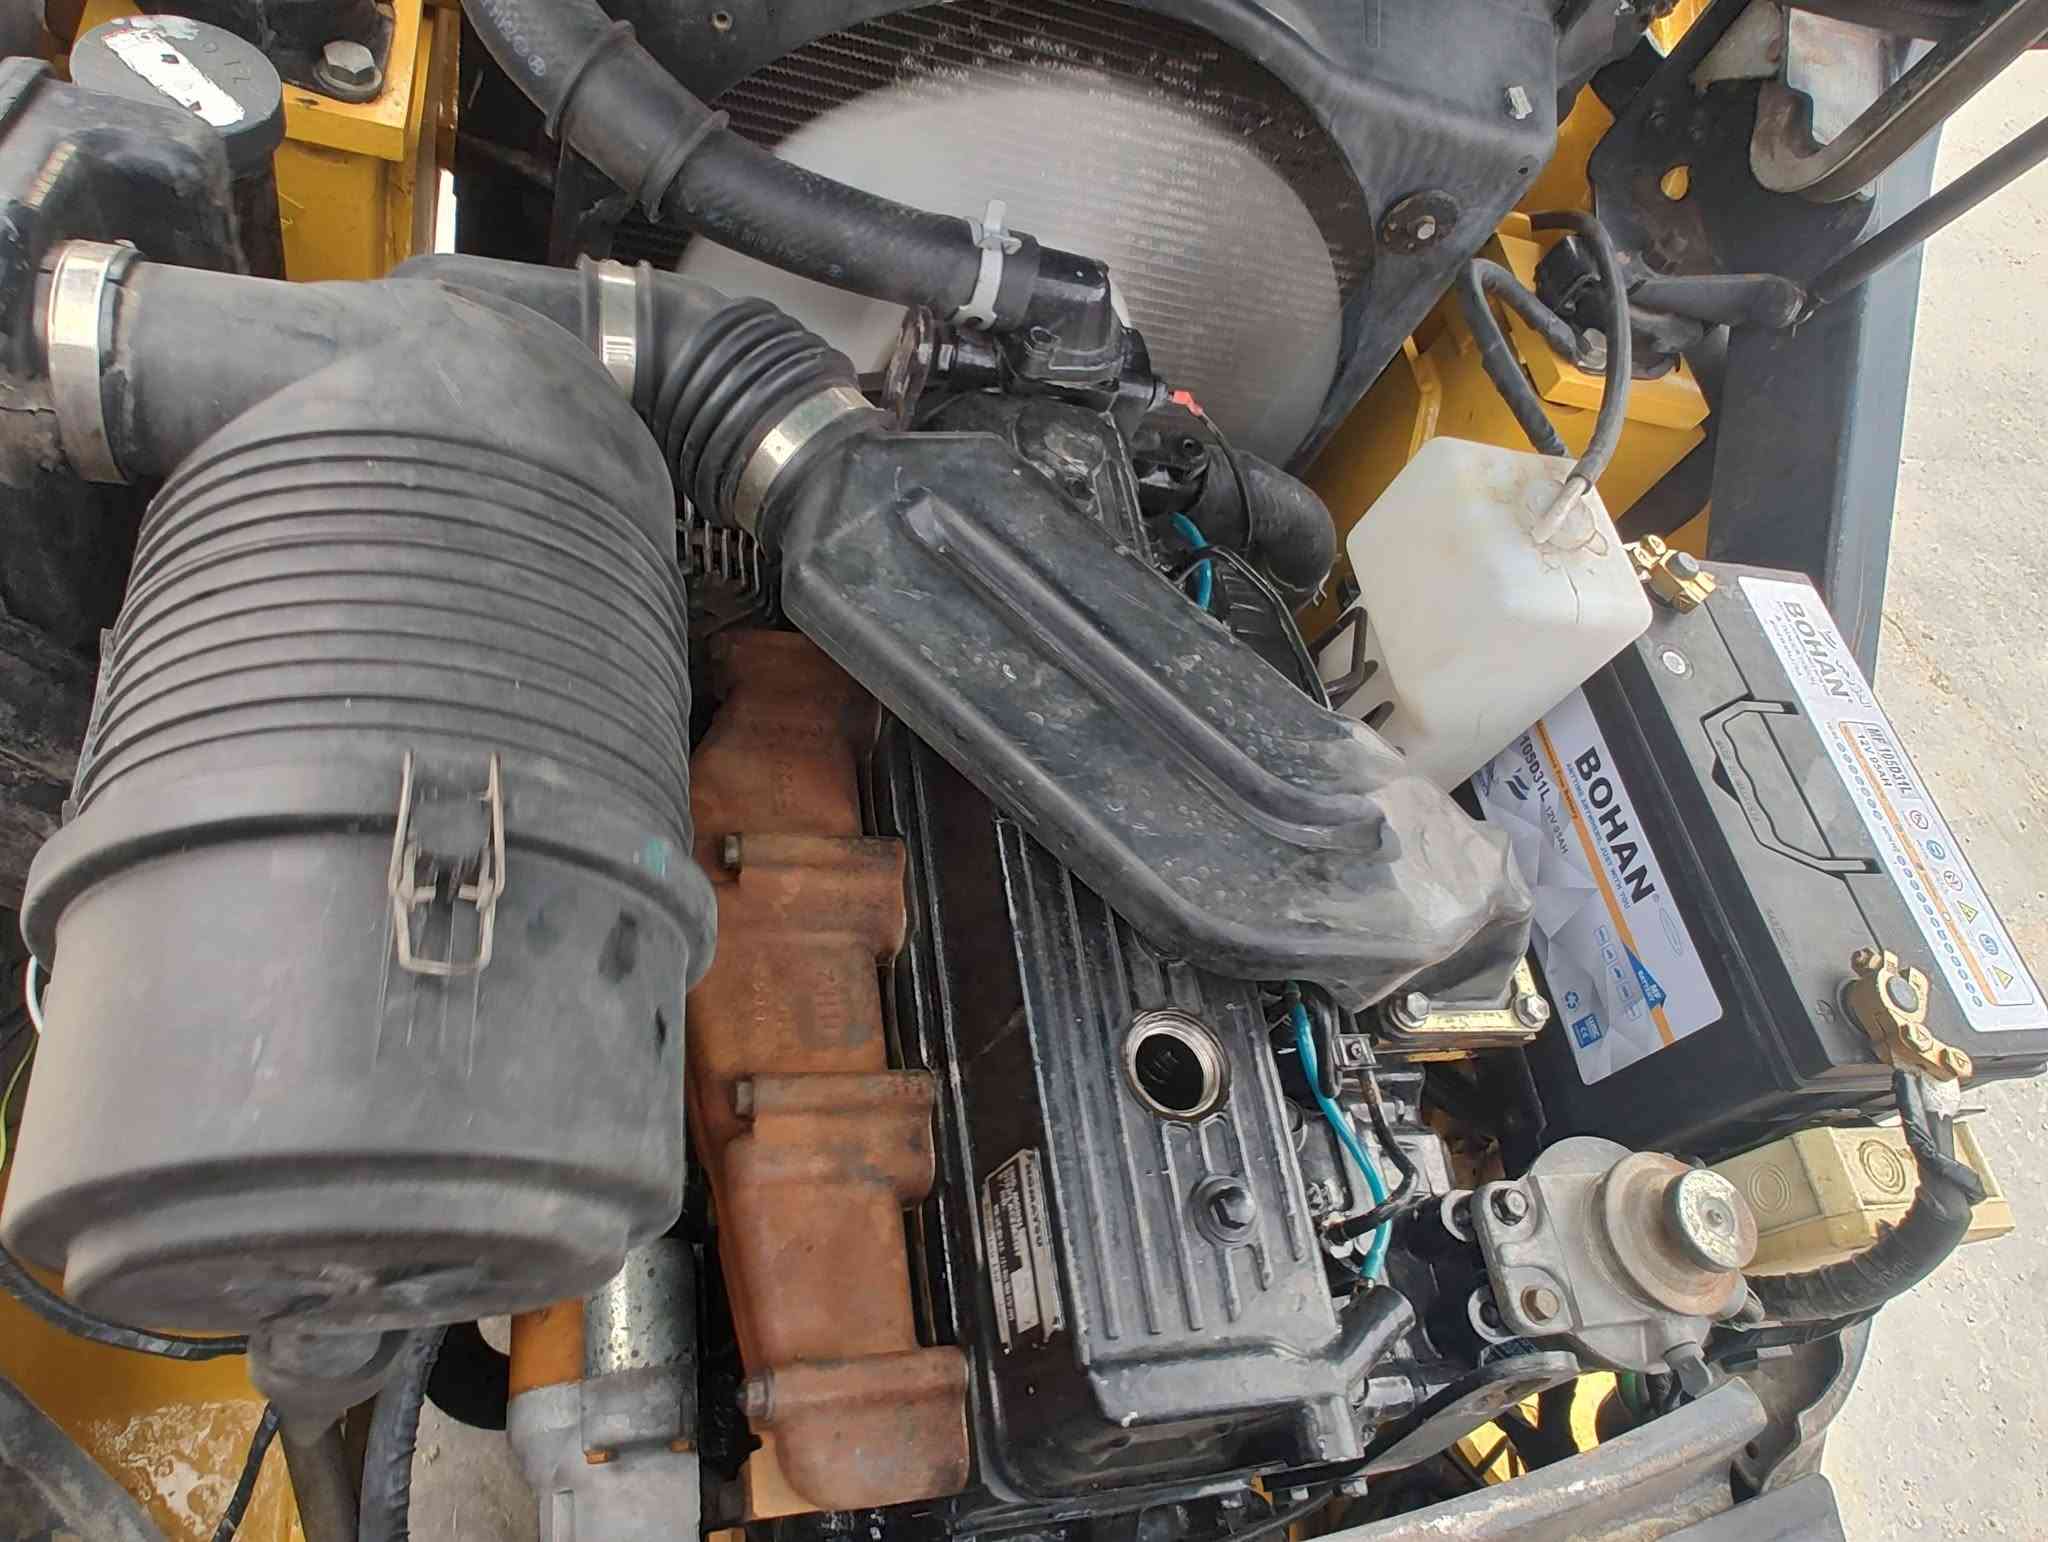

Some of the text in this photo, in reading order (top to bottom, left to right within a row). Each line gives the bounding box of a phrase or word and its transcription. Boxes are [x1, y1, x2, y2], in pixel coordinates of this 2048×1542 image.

[1783, 601, 1851, 697] BOHAN
[1519, 735, 1551, 803] 105D31L
[1857, 735, 1876, 755] 12V
[1866, 727, 1888, 746] MF
[1880, 747, 1913, 795] 105D31L
[1574, 746, 1656, 904] BOHAN
